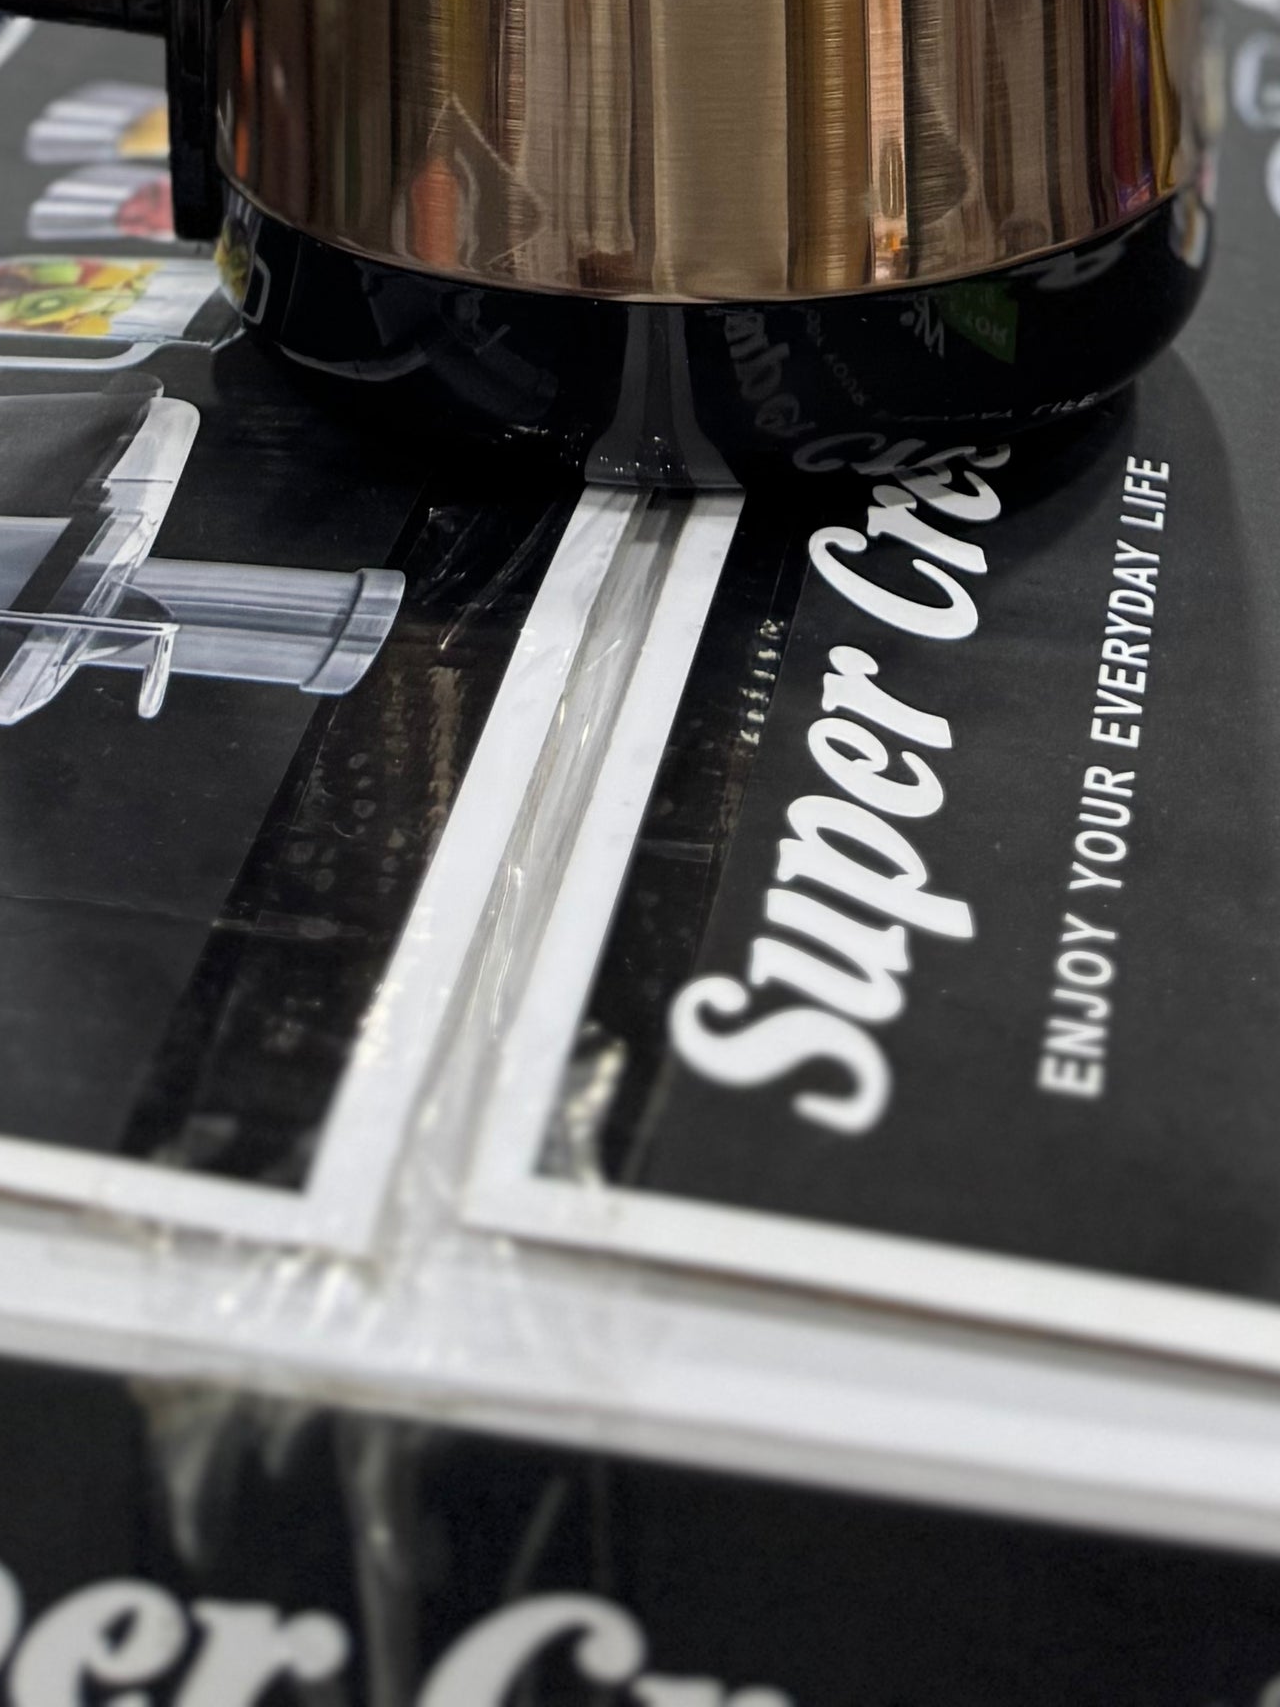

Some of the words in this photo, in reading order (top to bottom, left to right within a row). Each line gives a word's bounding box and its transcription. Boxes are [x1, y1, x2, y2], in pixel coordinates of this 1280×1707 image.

[808, 445, 1012, 640] Cre
[1120, 456, 1170, 531] LIFE
[1090, 539, 1160, 749] EVERYDAY
[670, 645, 975, 1133] Super
[1067, 765, 1136, 891] YOUR
[1039, 912, 1118, 1098] ENJOY
